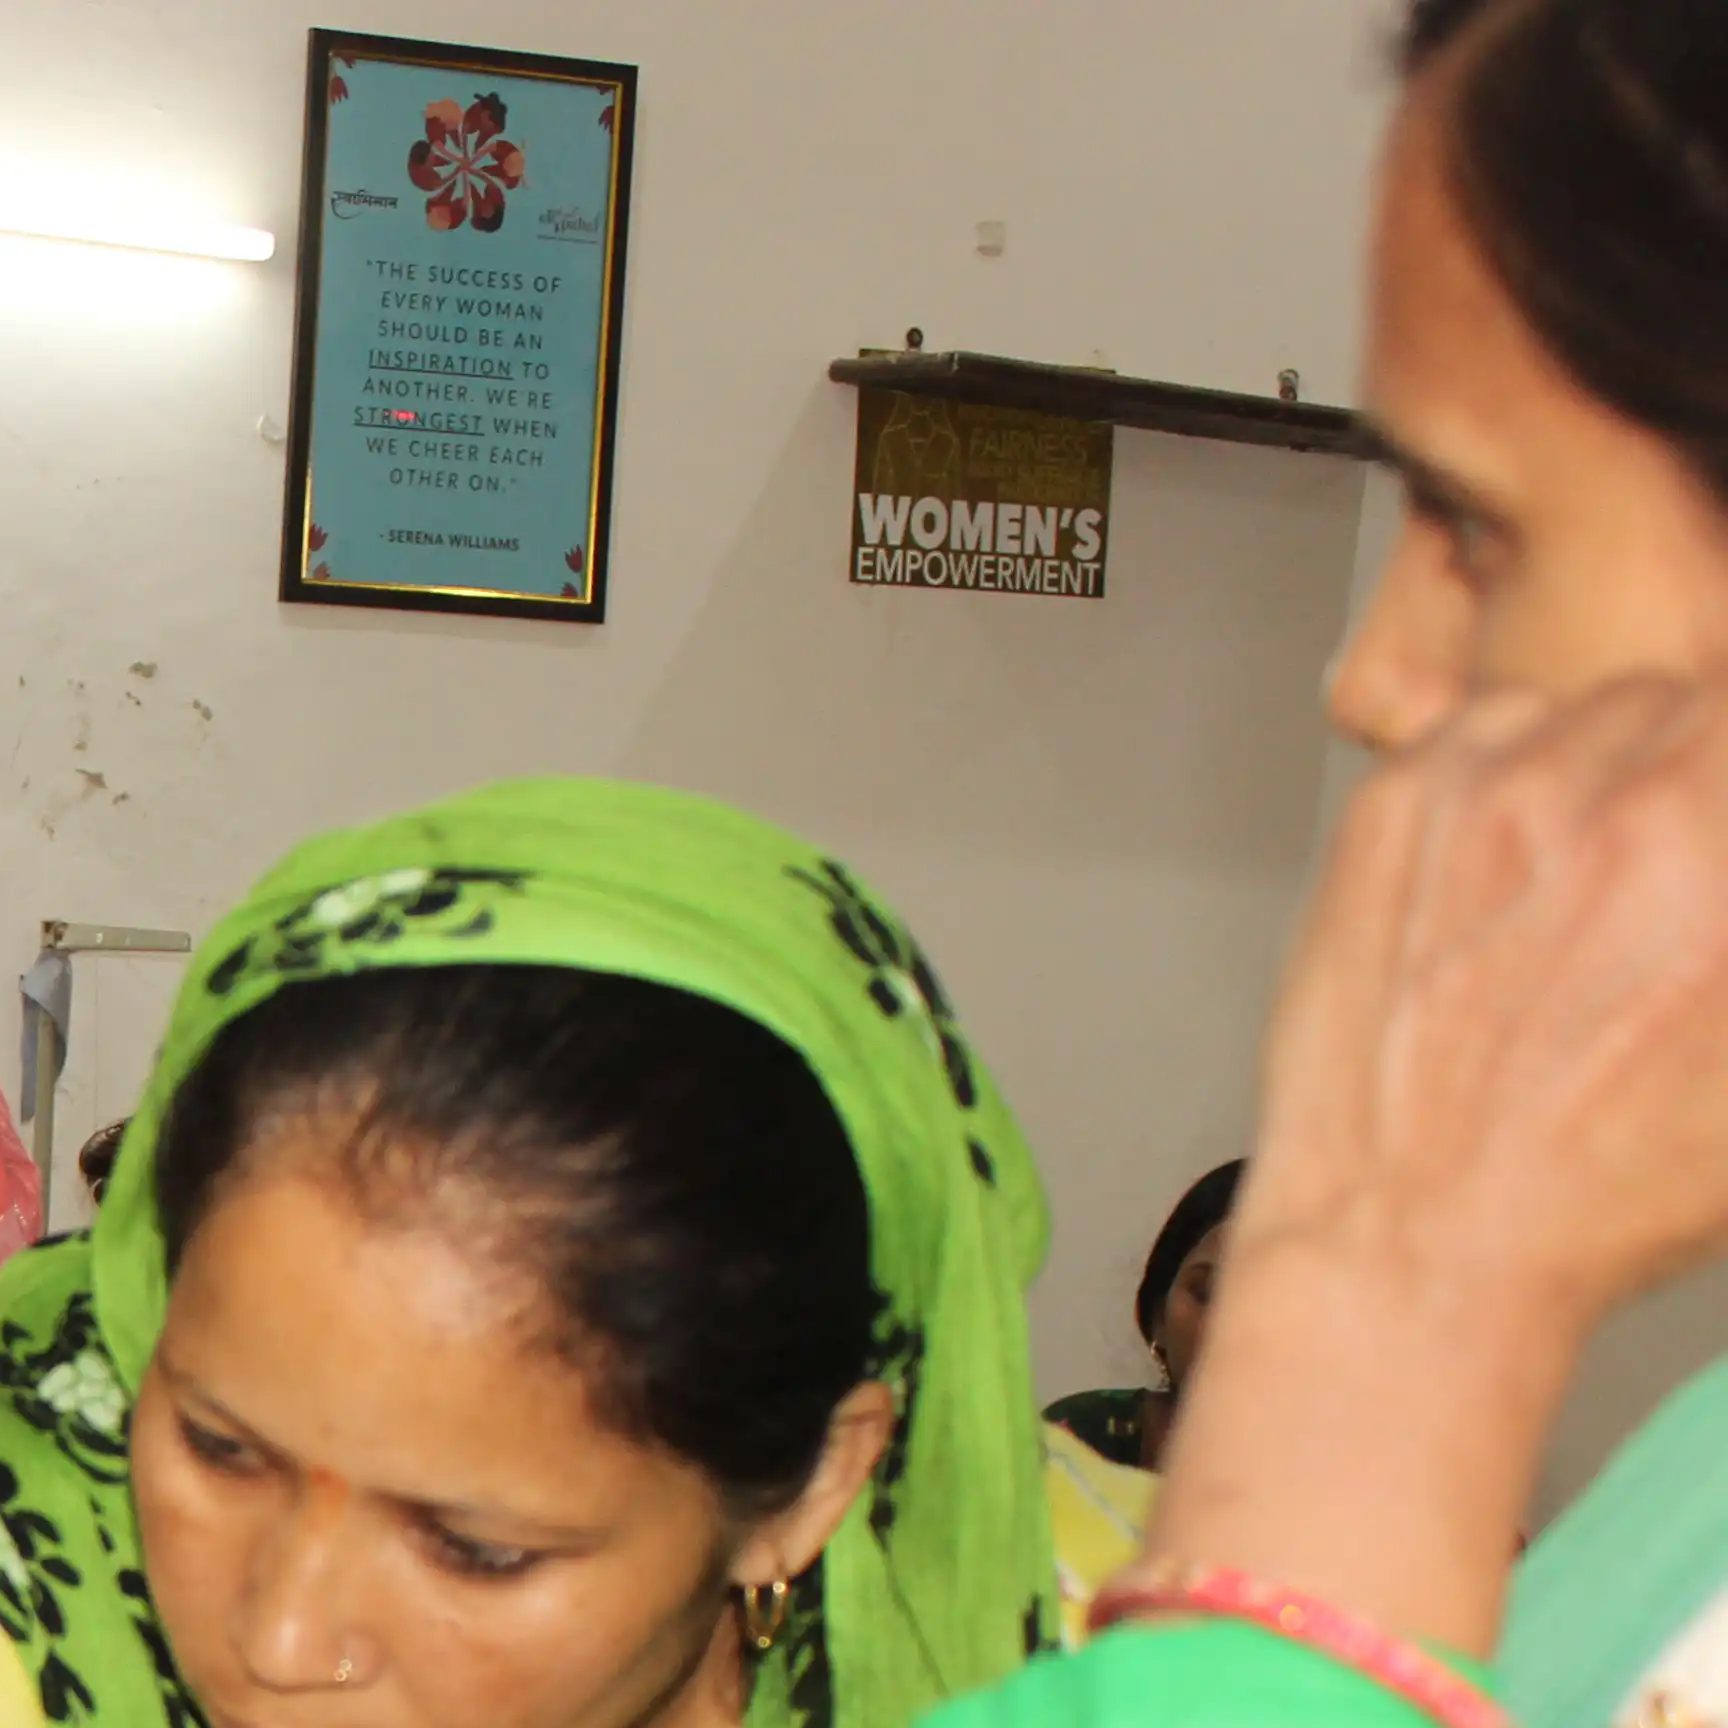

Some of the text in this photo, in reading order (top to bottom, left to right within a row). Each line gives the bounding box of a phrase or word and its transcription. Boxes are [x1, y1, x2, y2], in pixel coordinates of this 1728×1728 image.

[428, 265, 523, 291] SUCCESS
[534, 276, 563, 293] OF
[381, 291, 543, 321] EVERY WOMAN
[378, 320, 542, 350] SHOULD BE AN
[369, 349, 550, 380] INSPIRATION TO
[363, 376, 553, 410] ANOTHER. WE'RE
[354, 406, 558, 439] STRONGEST WHEN
[366, 436, 544, 468] WE CHEER EACH
[389, 468, 459, 489] OTHER
[388, 529, 444, 546] SERENA
[448, 534, 520, 551] WILLIAMS
[858, 493, 1103, 561] WOMEN'S
[856, 547, 1101, 597] EMPOWERMENT
